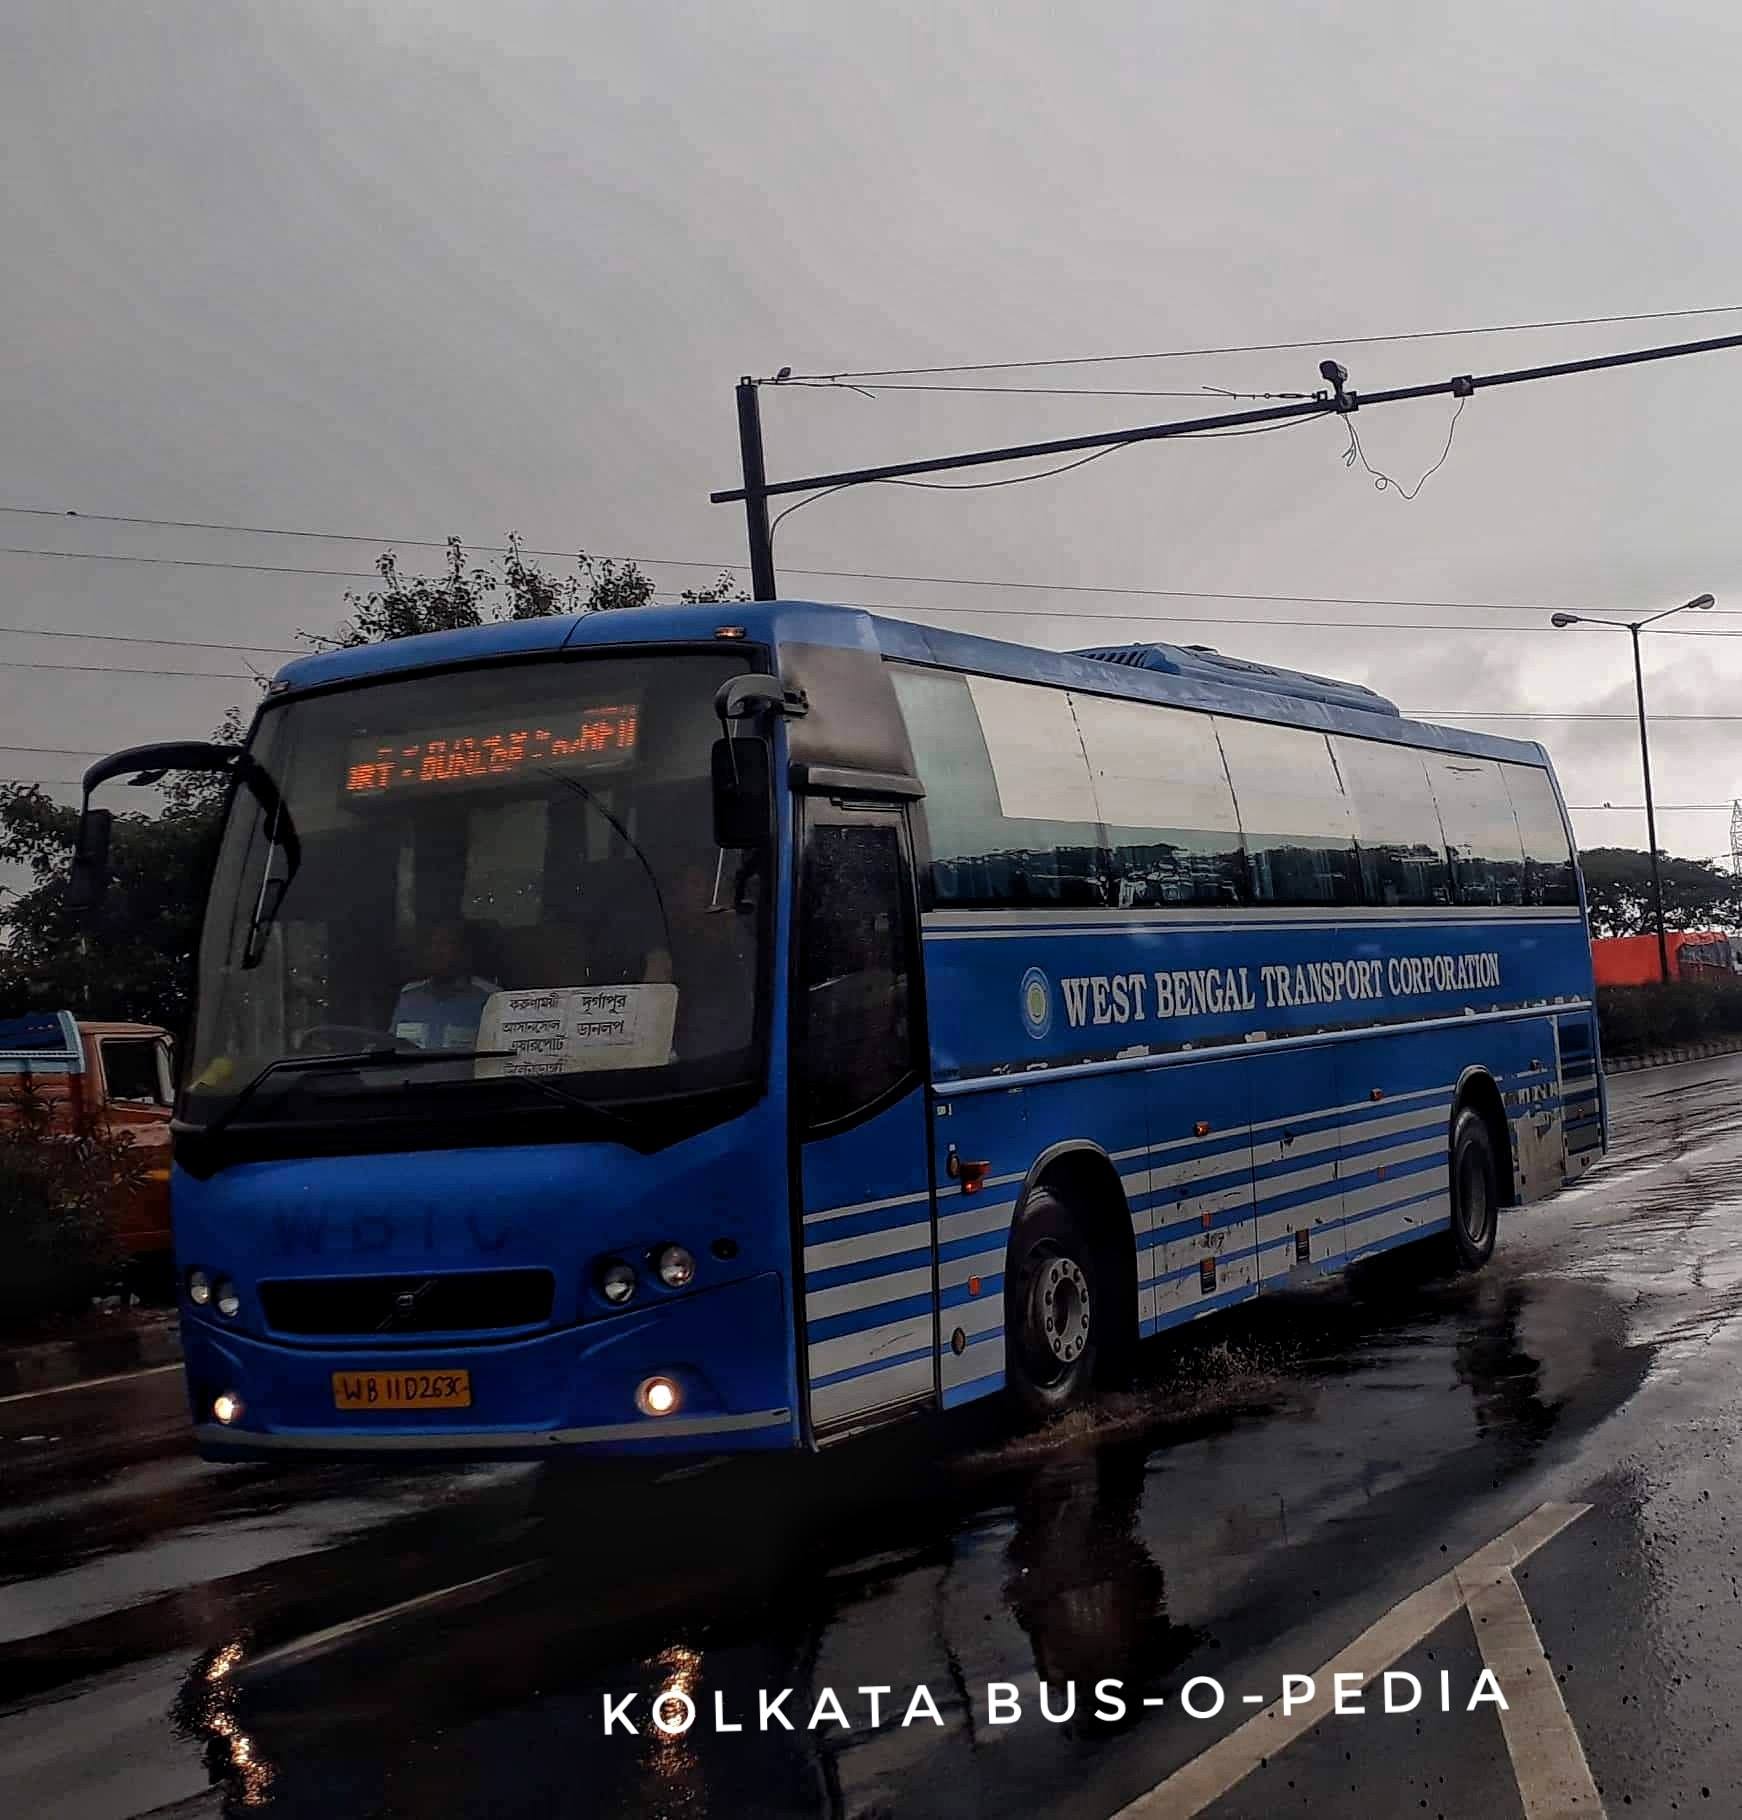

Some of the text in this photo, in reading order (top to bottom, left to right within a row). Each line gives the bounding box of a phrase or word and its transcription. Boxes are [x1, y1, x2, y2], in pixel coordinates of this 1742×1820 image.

[1061, 952, 1500, 1027] WEST BENGAL TRANSPORT CORPORATION
